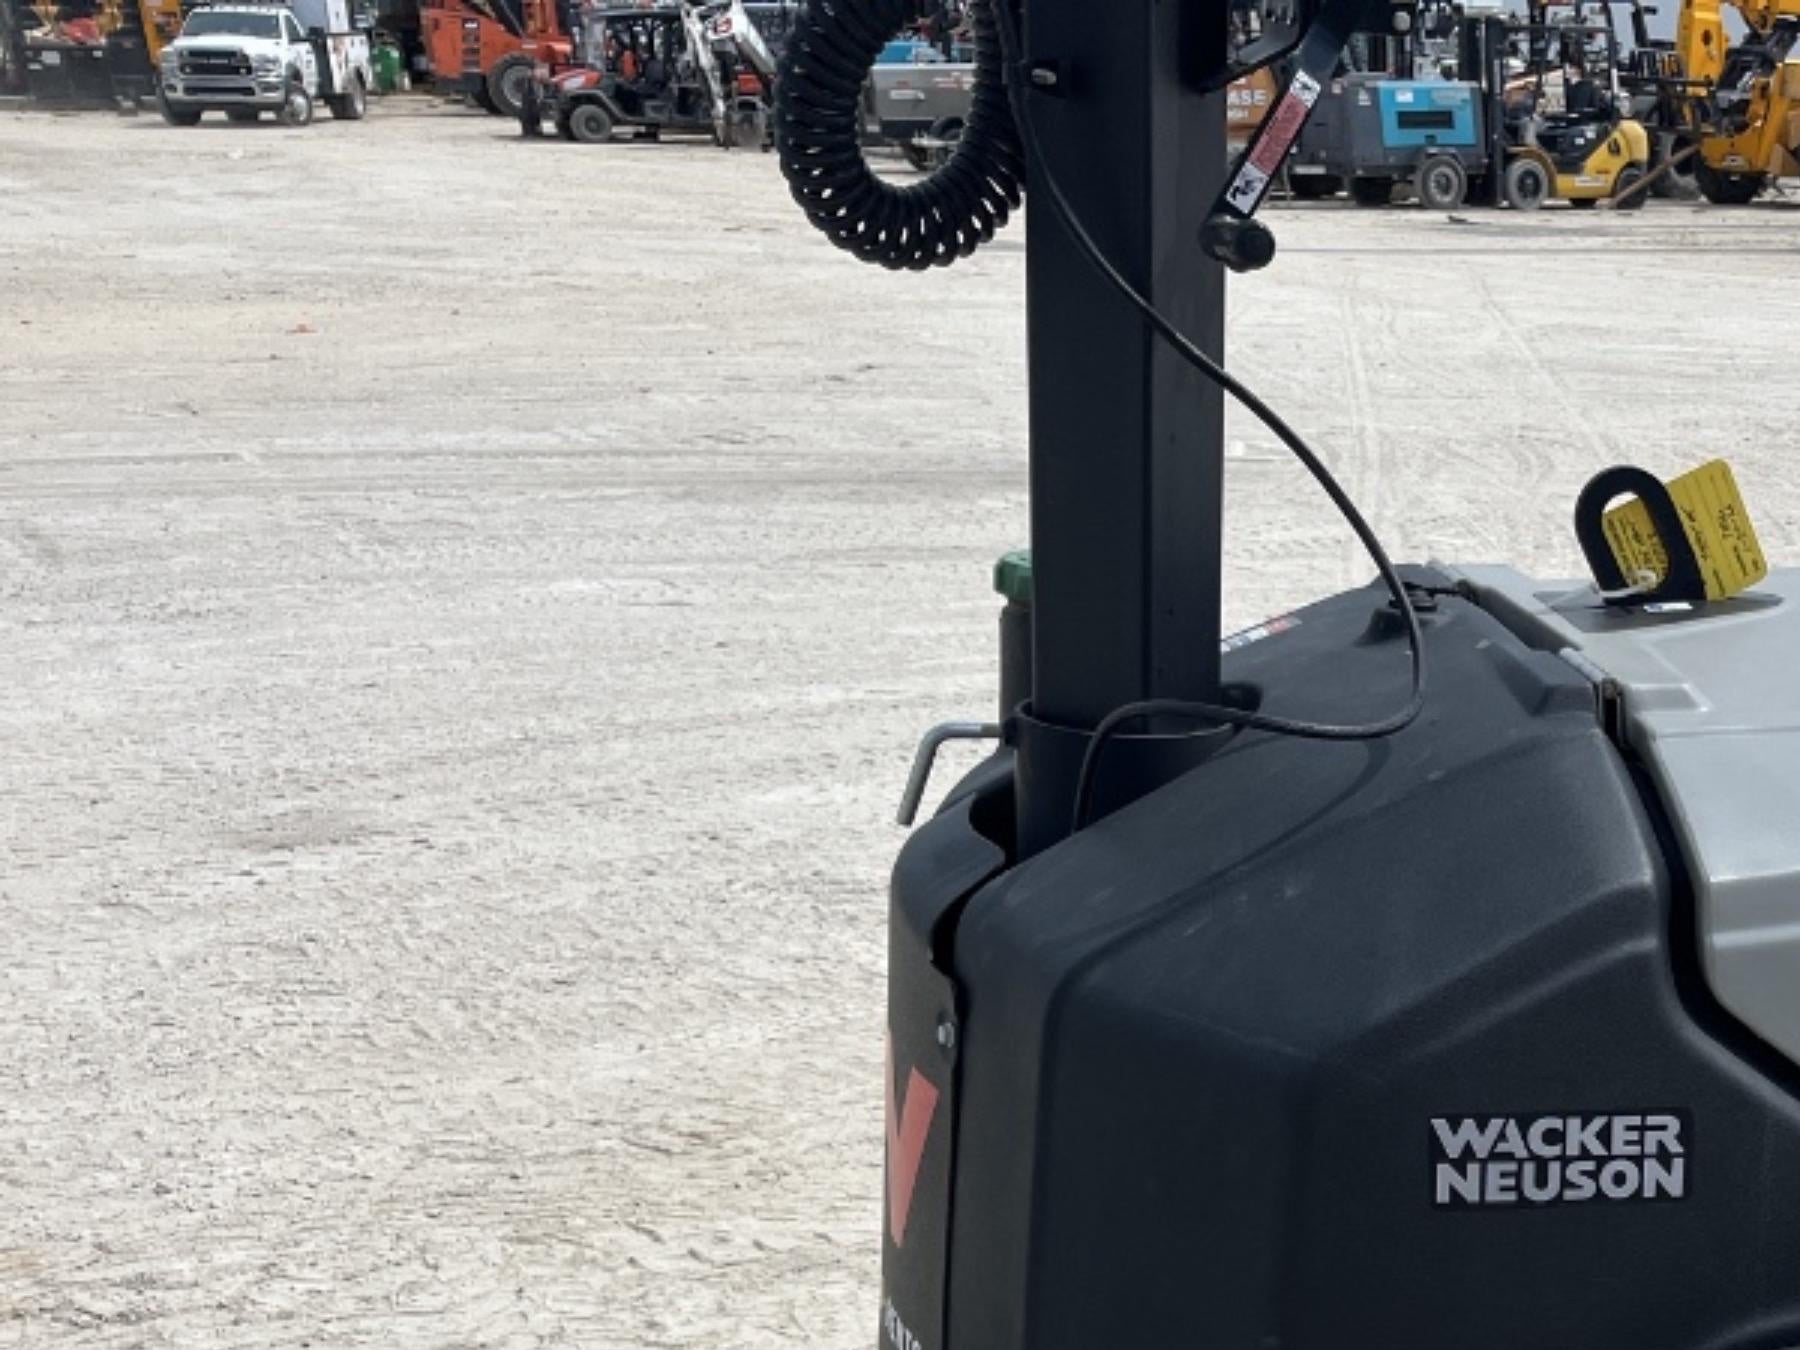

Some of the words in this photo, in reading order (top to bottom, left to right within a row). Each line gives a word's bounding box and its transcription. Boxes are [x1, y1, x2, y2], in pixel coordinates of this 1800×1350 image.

[1227, 89, 1267, 106] ASE
[1430, 1114, 1686, 1160] WACKER
[1436, 1157, 1686, 1205] NEUSON
